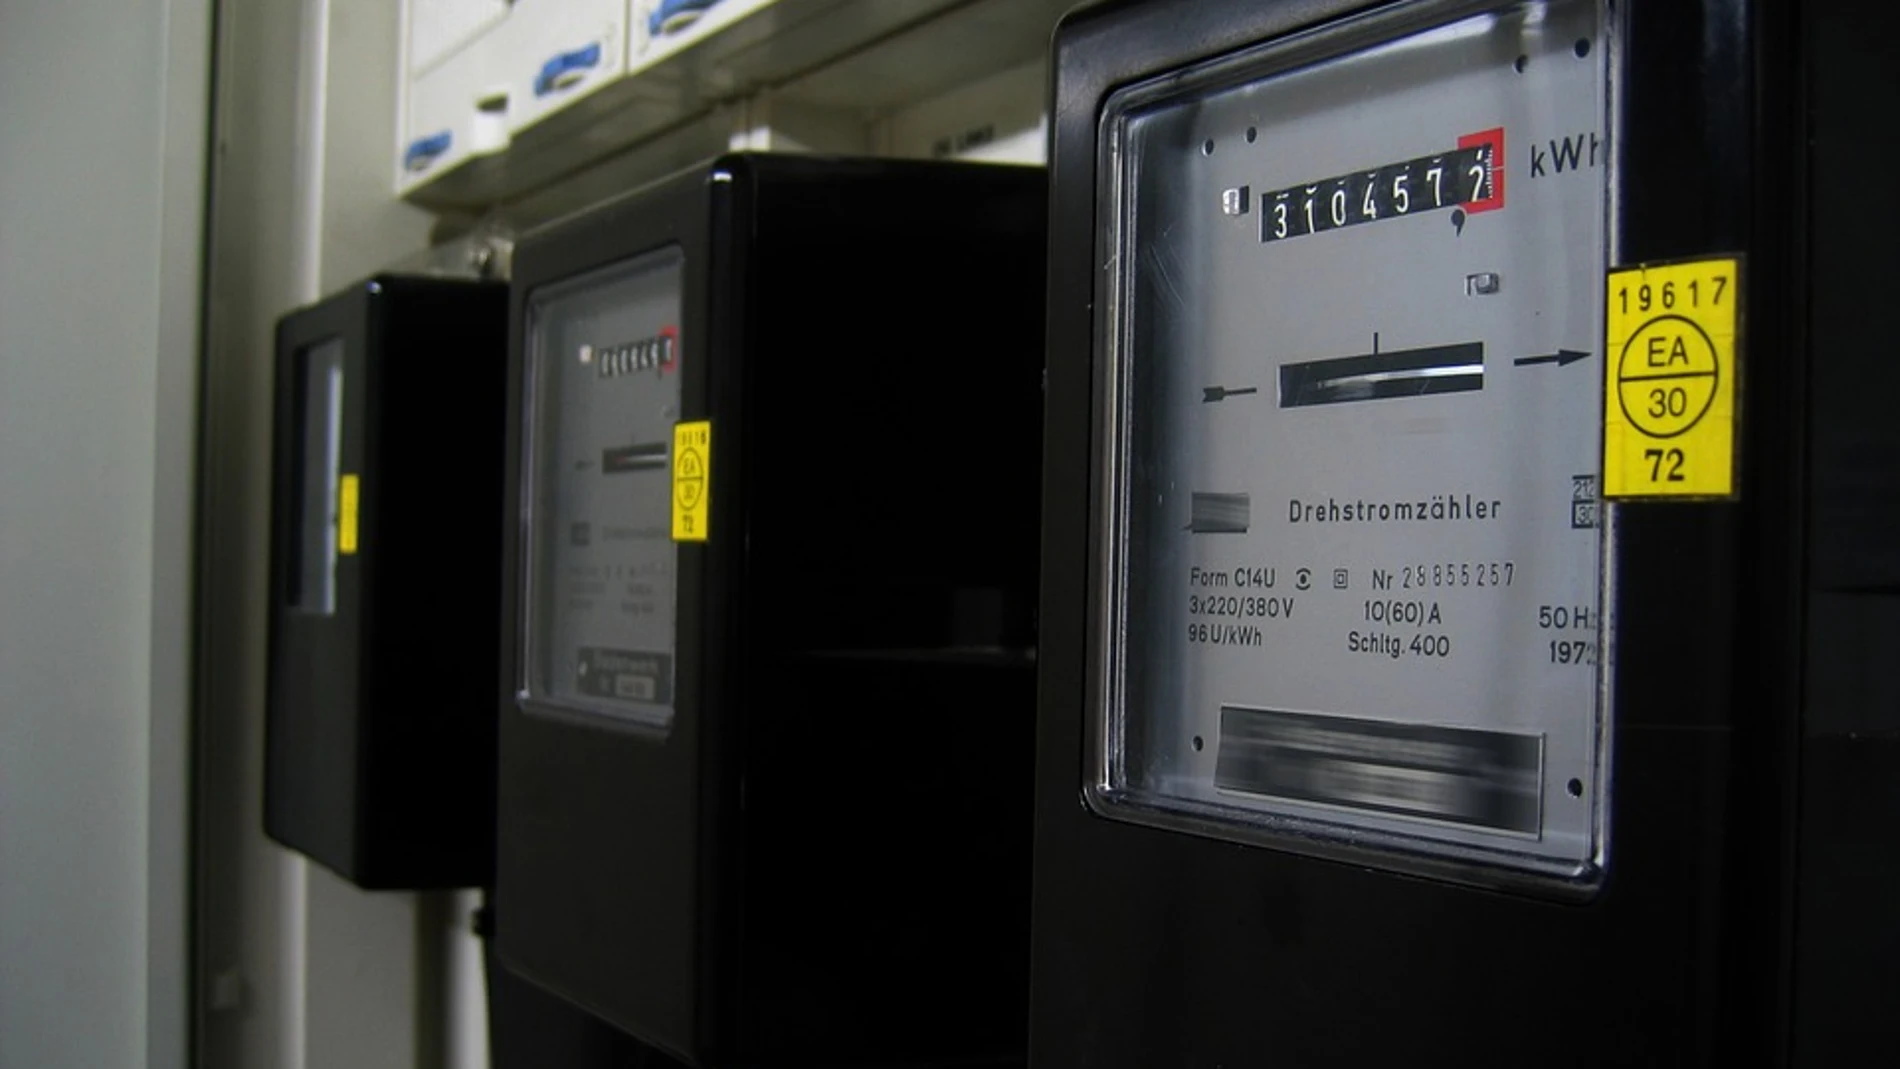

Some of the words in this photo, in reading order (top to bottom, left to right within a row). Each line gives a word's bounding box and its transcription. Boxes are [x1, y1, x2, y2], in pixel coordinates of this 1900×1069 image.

[1618, 276, 1727, 314] 19617
[1647, 336, 1689, 368] EA
[1648, 387, 1687, 418] 30
[1644, 448, 1685, 482] 72
[1289, 494, 1501, 523] Drehstromzähler
[1190, 567, 1229, 588] Form
[1234, 567, 1276, 589] C14U
[1372, 569, 1393, 590] Nr
[1539, 605, 1569, 629] 50
[1348, 630, 1406, 659] Schltg.
[1410, 633, 1451, 657] 400
